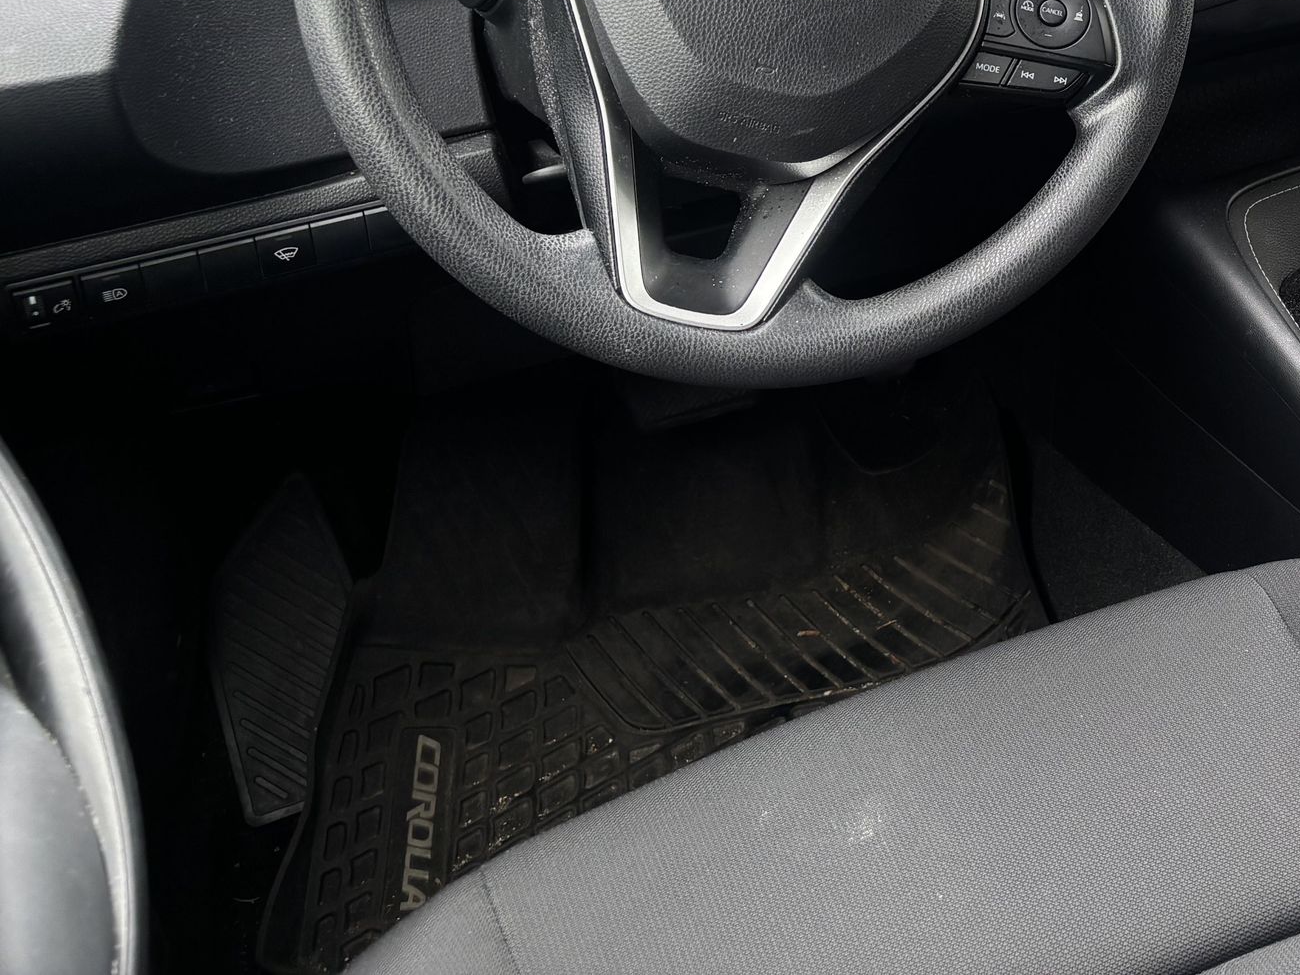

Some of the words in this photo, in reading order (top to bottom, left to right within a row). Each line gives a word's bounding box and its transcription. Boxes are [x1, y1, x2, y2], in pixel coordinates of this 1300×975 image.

[1042, 6, 1063, 16] CANCEL
[976, 62, 1000, 73] MODE
[400, 734, 441, 911] COROLLA
